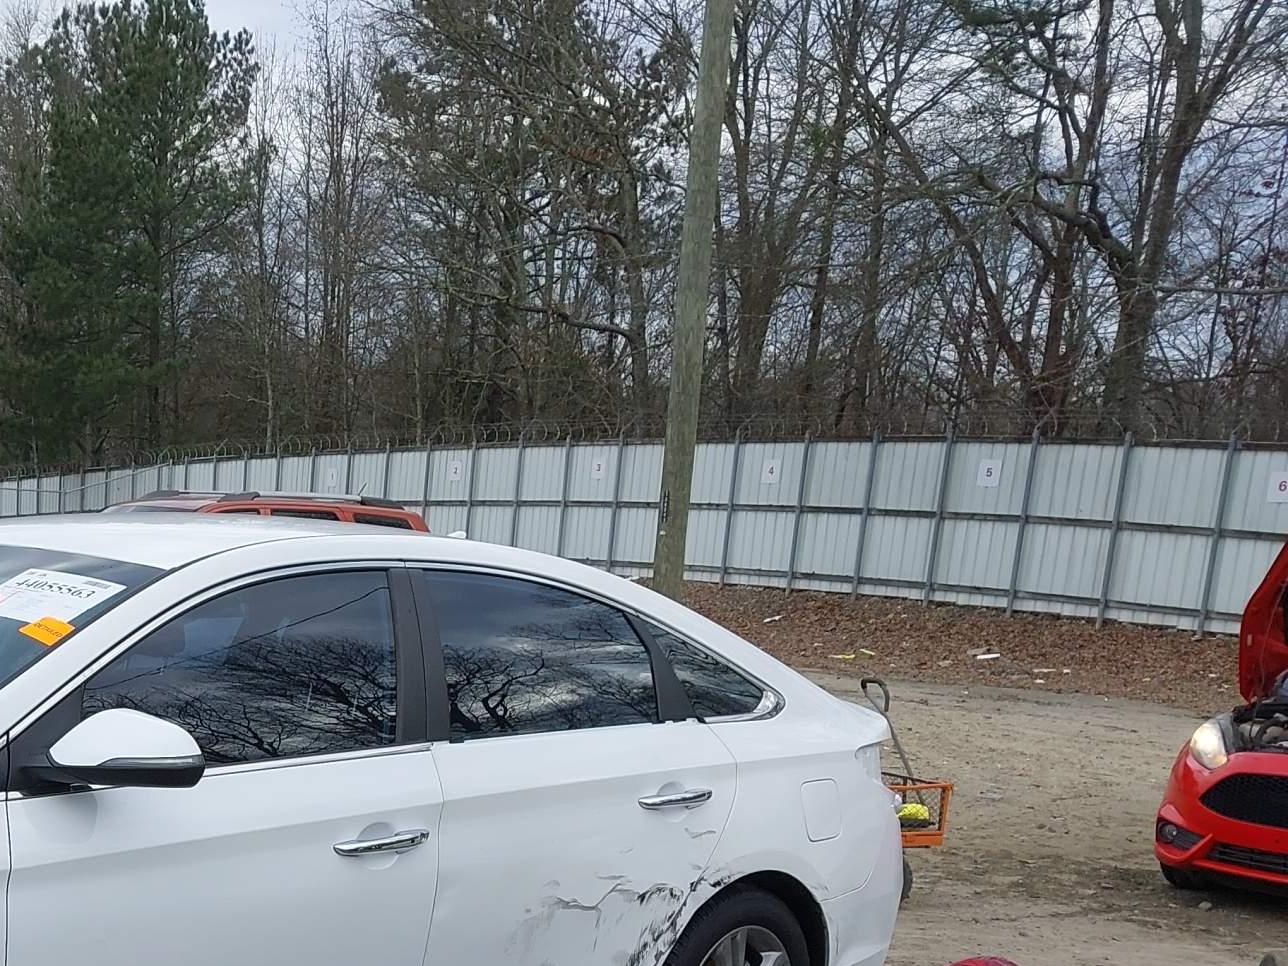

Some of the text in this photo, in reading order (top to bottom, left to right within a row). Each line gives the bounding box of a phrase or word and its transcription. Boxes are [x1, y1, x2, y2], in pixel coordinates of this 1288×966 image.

[768, 466, 775, 476] 4
[985, 467, 993, 478] 5
[1278, 480, 1288, 492] 6
[15, 578, 96, 599] 44055563
